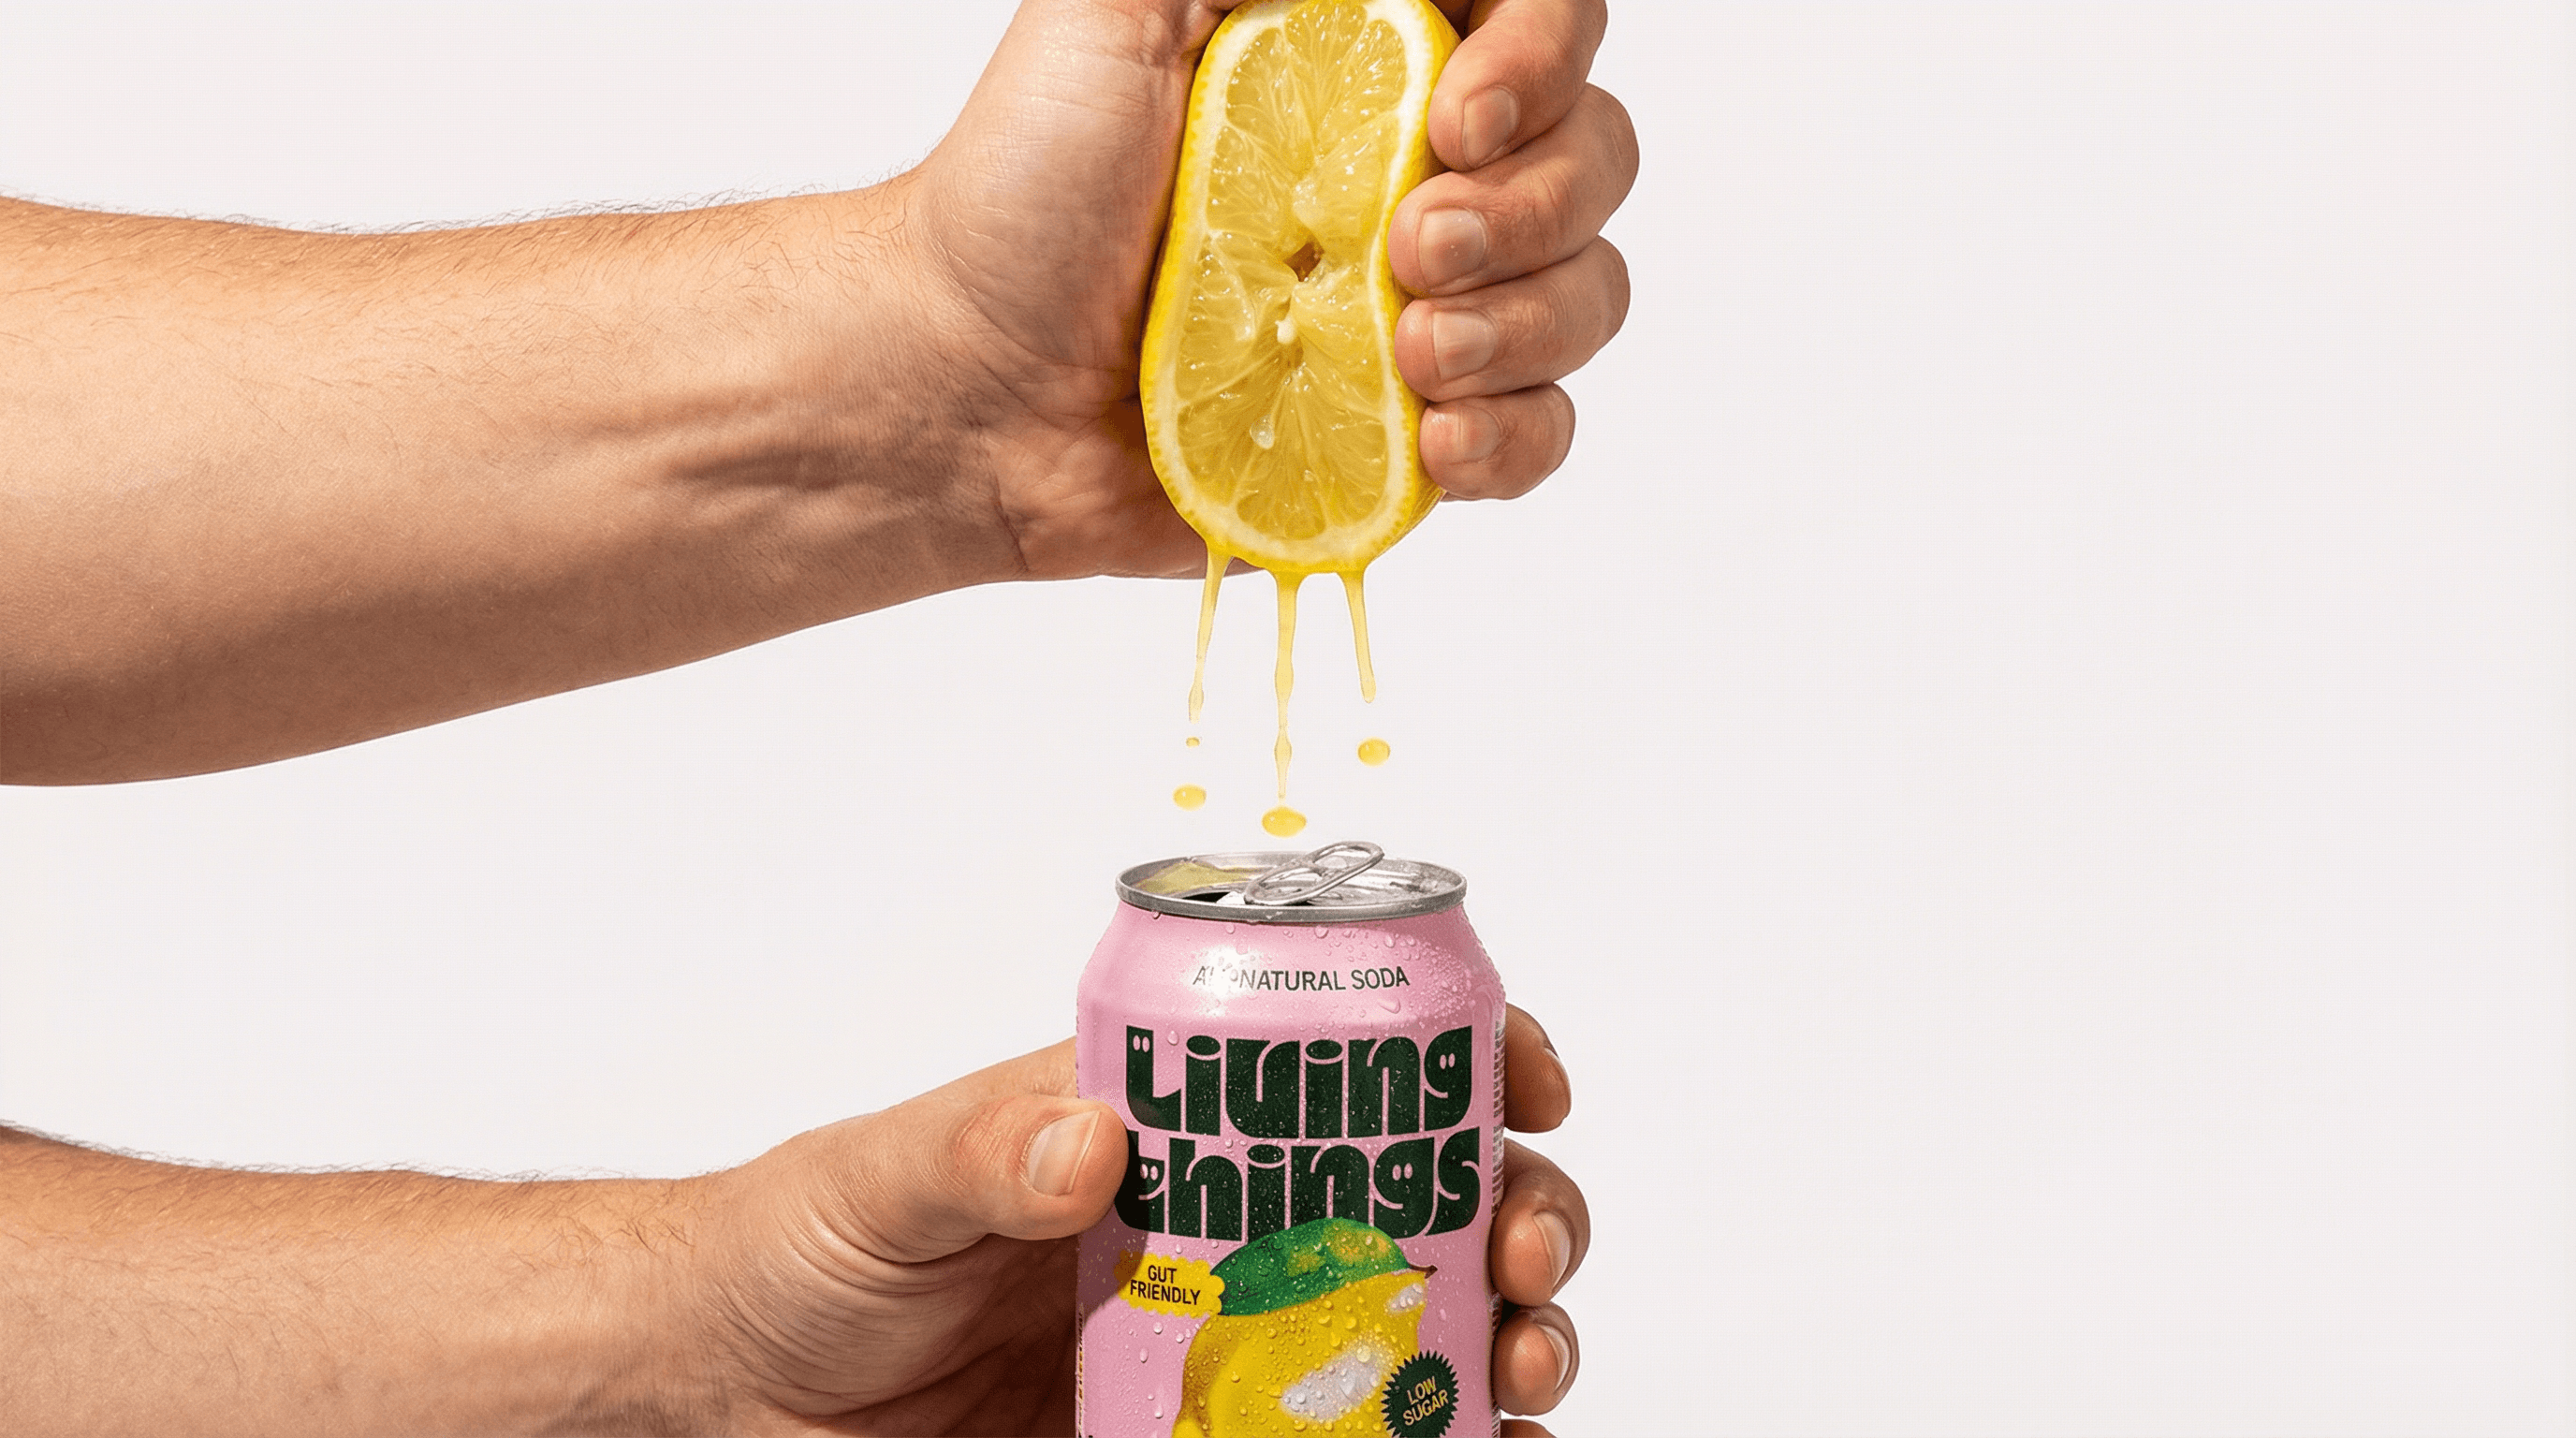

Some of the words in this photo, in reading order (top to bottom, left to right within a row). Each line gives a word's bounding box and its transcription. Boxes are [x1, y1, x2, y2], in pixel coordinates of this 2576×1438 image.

[1239, 969, 1346, 990] NATURAL
[1351, 966, 1410, 989] SODA
[1114, 1126, 1481, 1242] things
[1148, 1264, 1177, 1284] GUT
[1130, 1279, 1201, 1305] FRIENDLY
[1407, 1375, 1436, 1404] LOW
[1402, 1388, 1449, 1426] SUGAR
